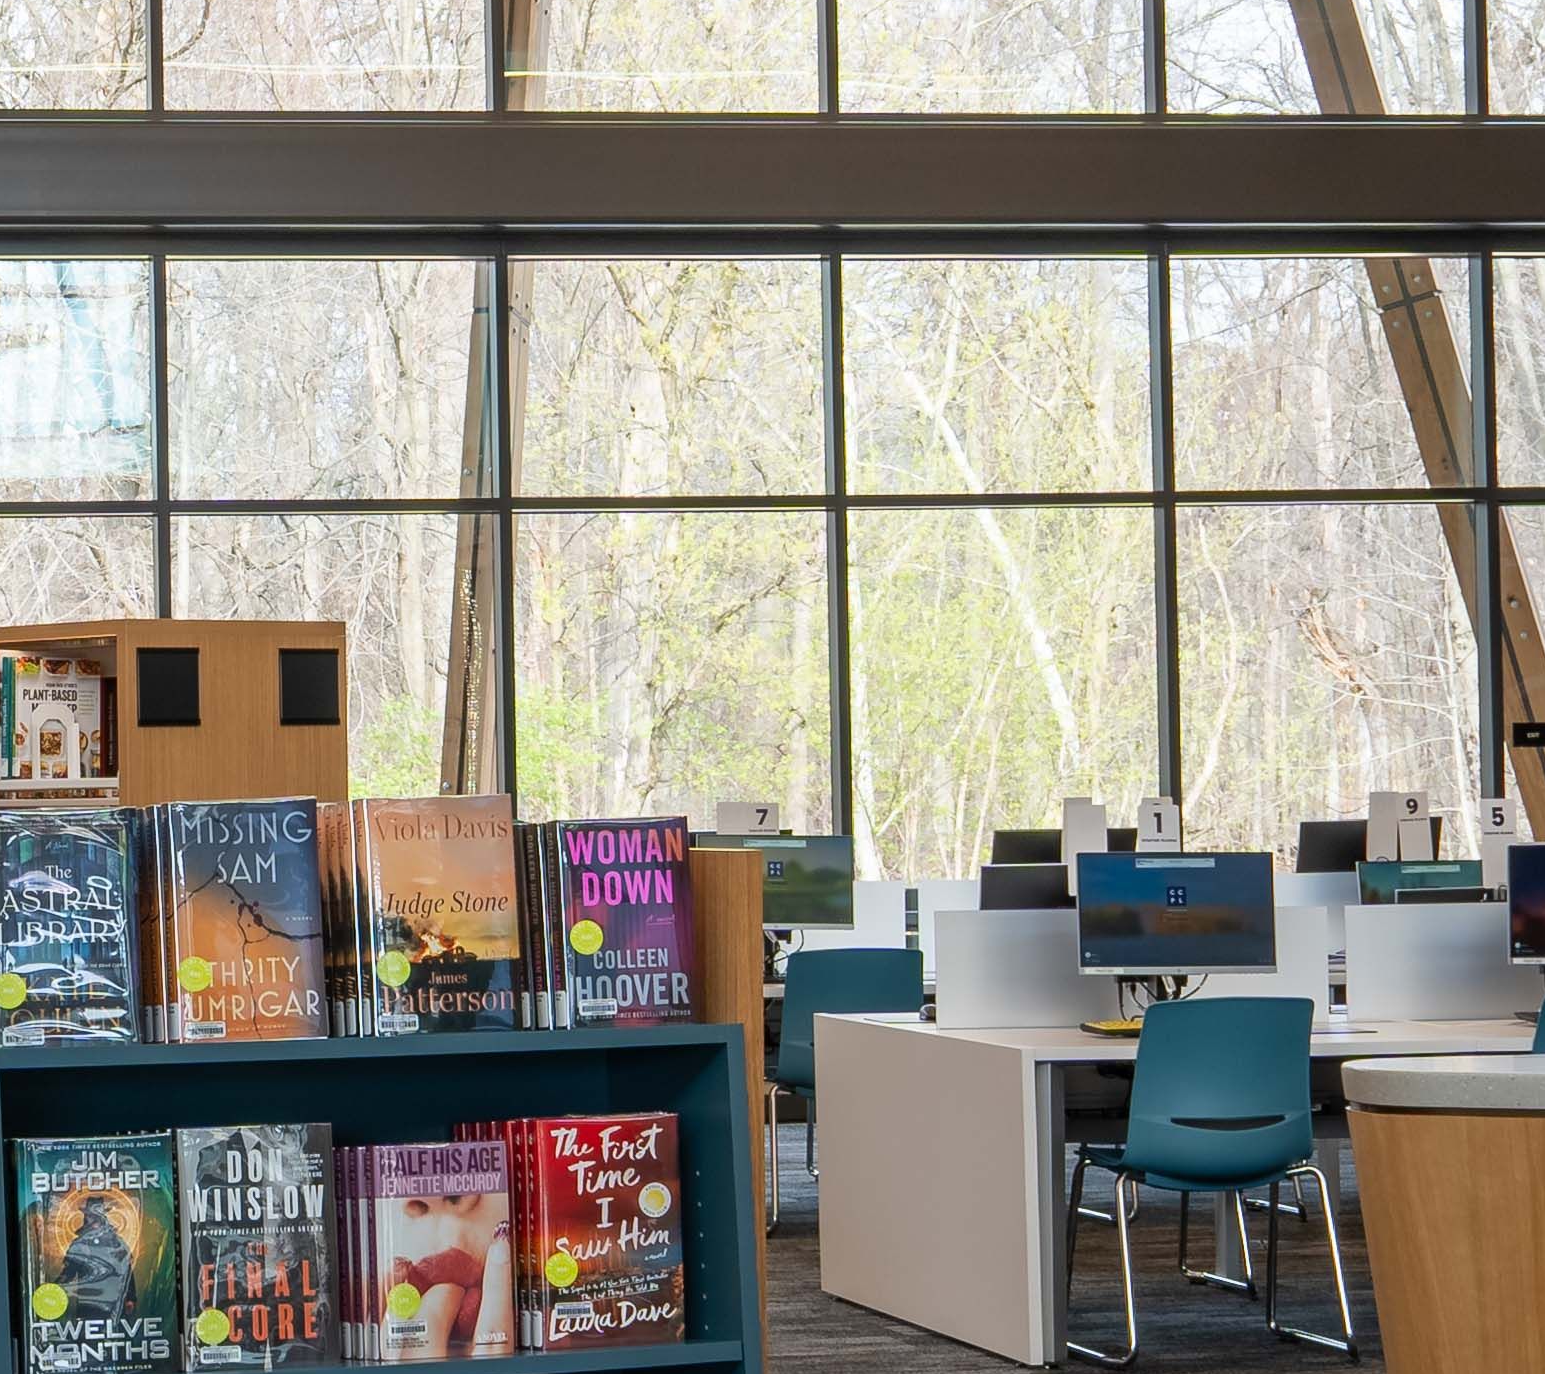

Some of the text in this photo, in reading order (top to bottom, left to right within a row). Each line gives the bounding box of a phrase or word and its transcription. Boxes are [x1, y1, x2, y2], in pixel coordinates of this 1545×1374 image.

[23, 689, 77, 701] PLANT-BASED
[756, 809, 768, 825] 7
[1406, 799, 1418, 814] 9
[1492, 807, 1505, 826] 5
[180, 811, 312, 844] MISSING
[374, 814, 508, 842] Viola Davis
[1154, 813, 1162, 833] 1
[566, 827, 683, 866] WOMAN
[44, 865, 72, 879] The
[217, 851, 277, 884] SAM
[582, 870, 674, 907] DOWN
[0, 888, 121, 920] ASTRAL
[386, 890, 508, 919] Judge Stone
[209, 956, 300, 988] THRITY
[594, 948, 668, 969] COLLEEN
[428, 971, 468, 984] James
[575, 973, 690, 1008] HOOVER
[183, 990, 320, 1022] UMRIGAR
[381, 987, 516, 1014] Patterson
[550, 1124, 663, 1163] The First
[71, 1151, 117, 1170] JIM
[227, 1149, 284, 1183] DON
[379, 1147, 501, 1177] HALF HIS AGE
[31, 1171, 161, 1193] BUTCHER
[381, 1172, 501, 1195] JENNETTE MCCURDY
[568, 1160, 640, 1195] Time
[186, 1185, 325, 1223] WINSLOW
[596, 1197, 614, 1230] I
[556, 1217, 670, 1260] Saw Him
[200, 1260, 316, 1301] FINAL
[32, 1317, 163, 1342] TWELVE
[30, 1340, 169, 1364] MONTHS
